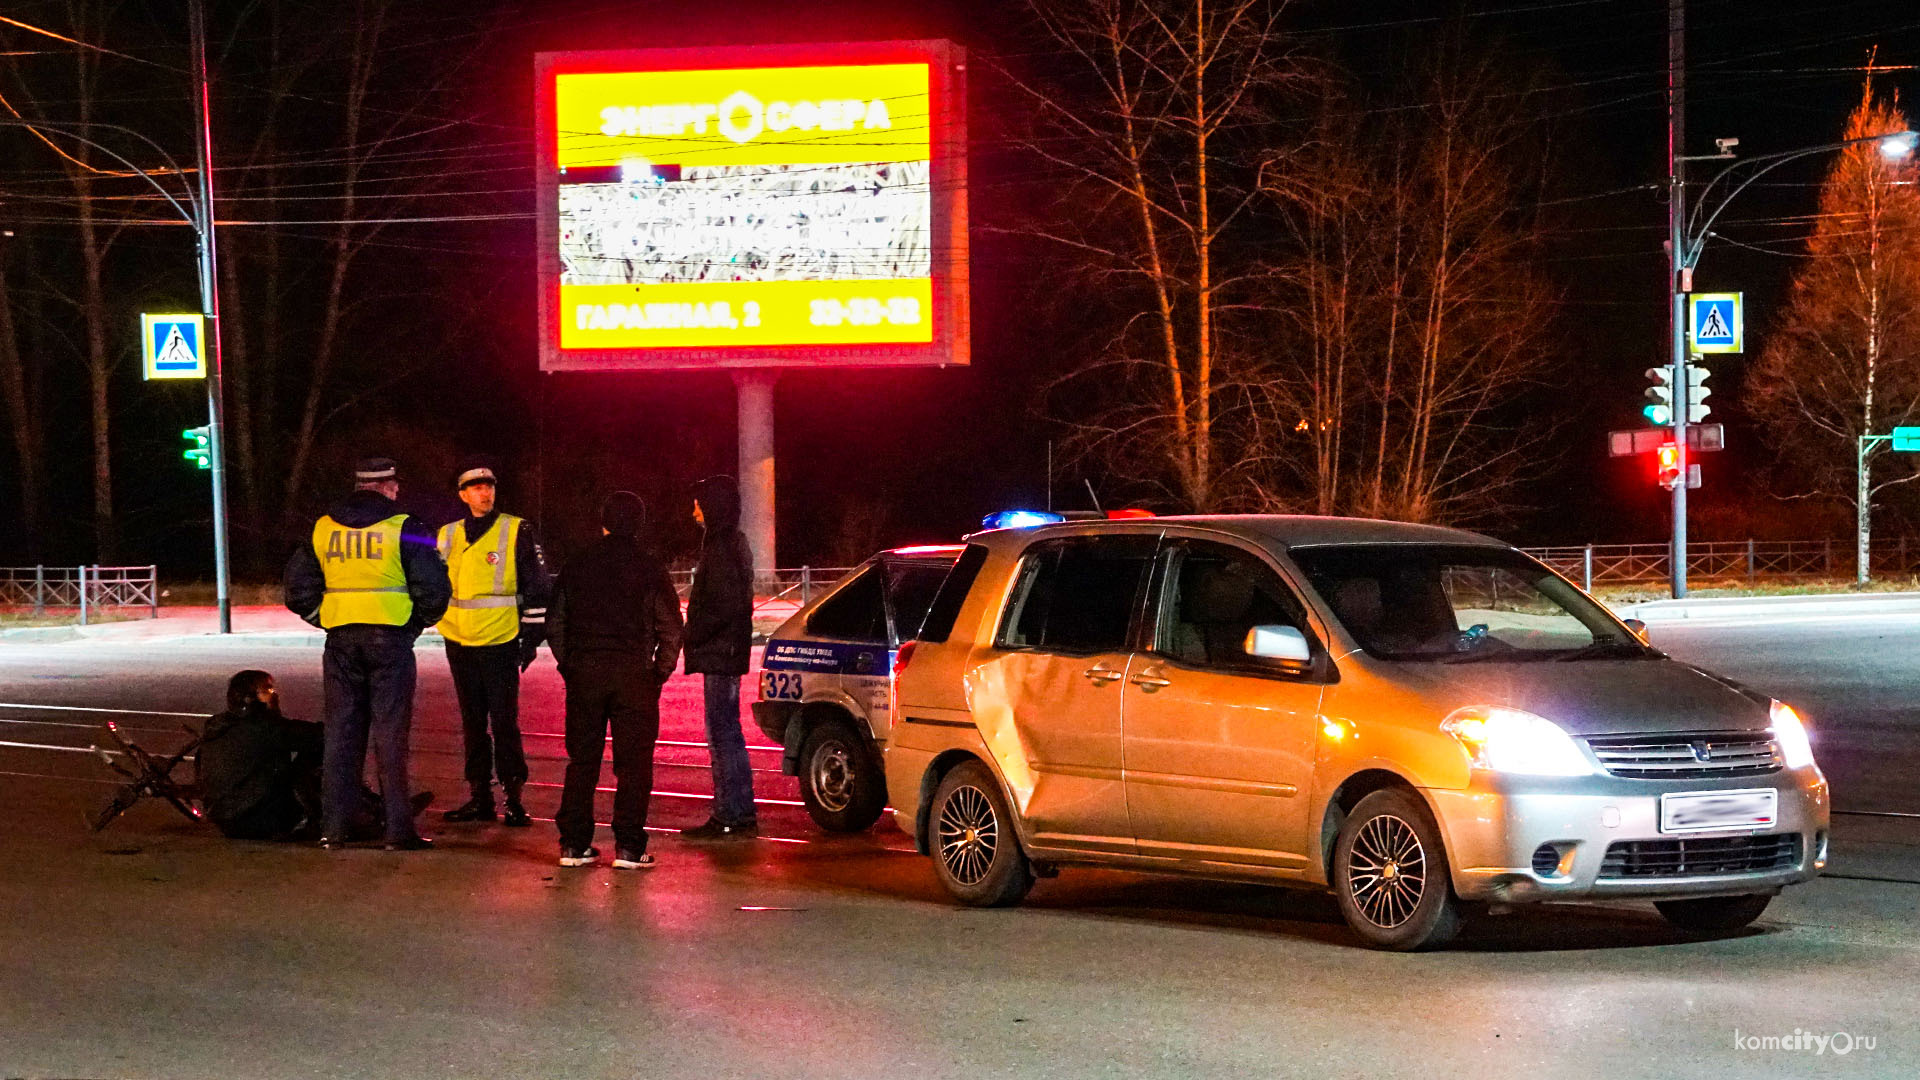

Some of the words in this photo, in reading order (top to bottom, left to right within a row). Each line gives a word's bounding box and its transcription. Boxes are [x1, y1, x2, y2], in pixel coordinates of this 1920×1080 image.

[743, 300, 761, 327] 2
[326, 530, 384, 563] ДПС
[765, 672, 803, 700] 323
